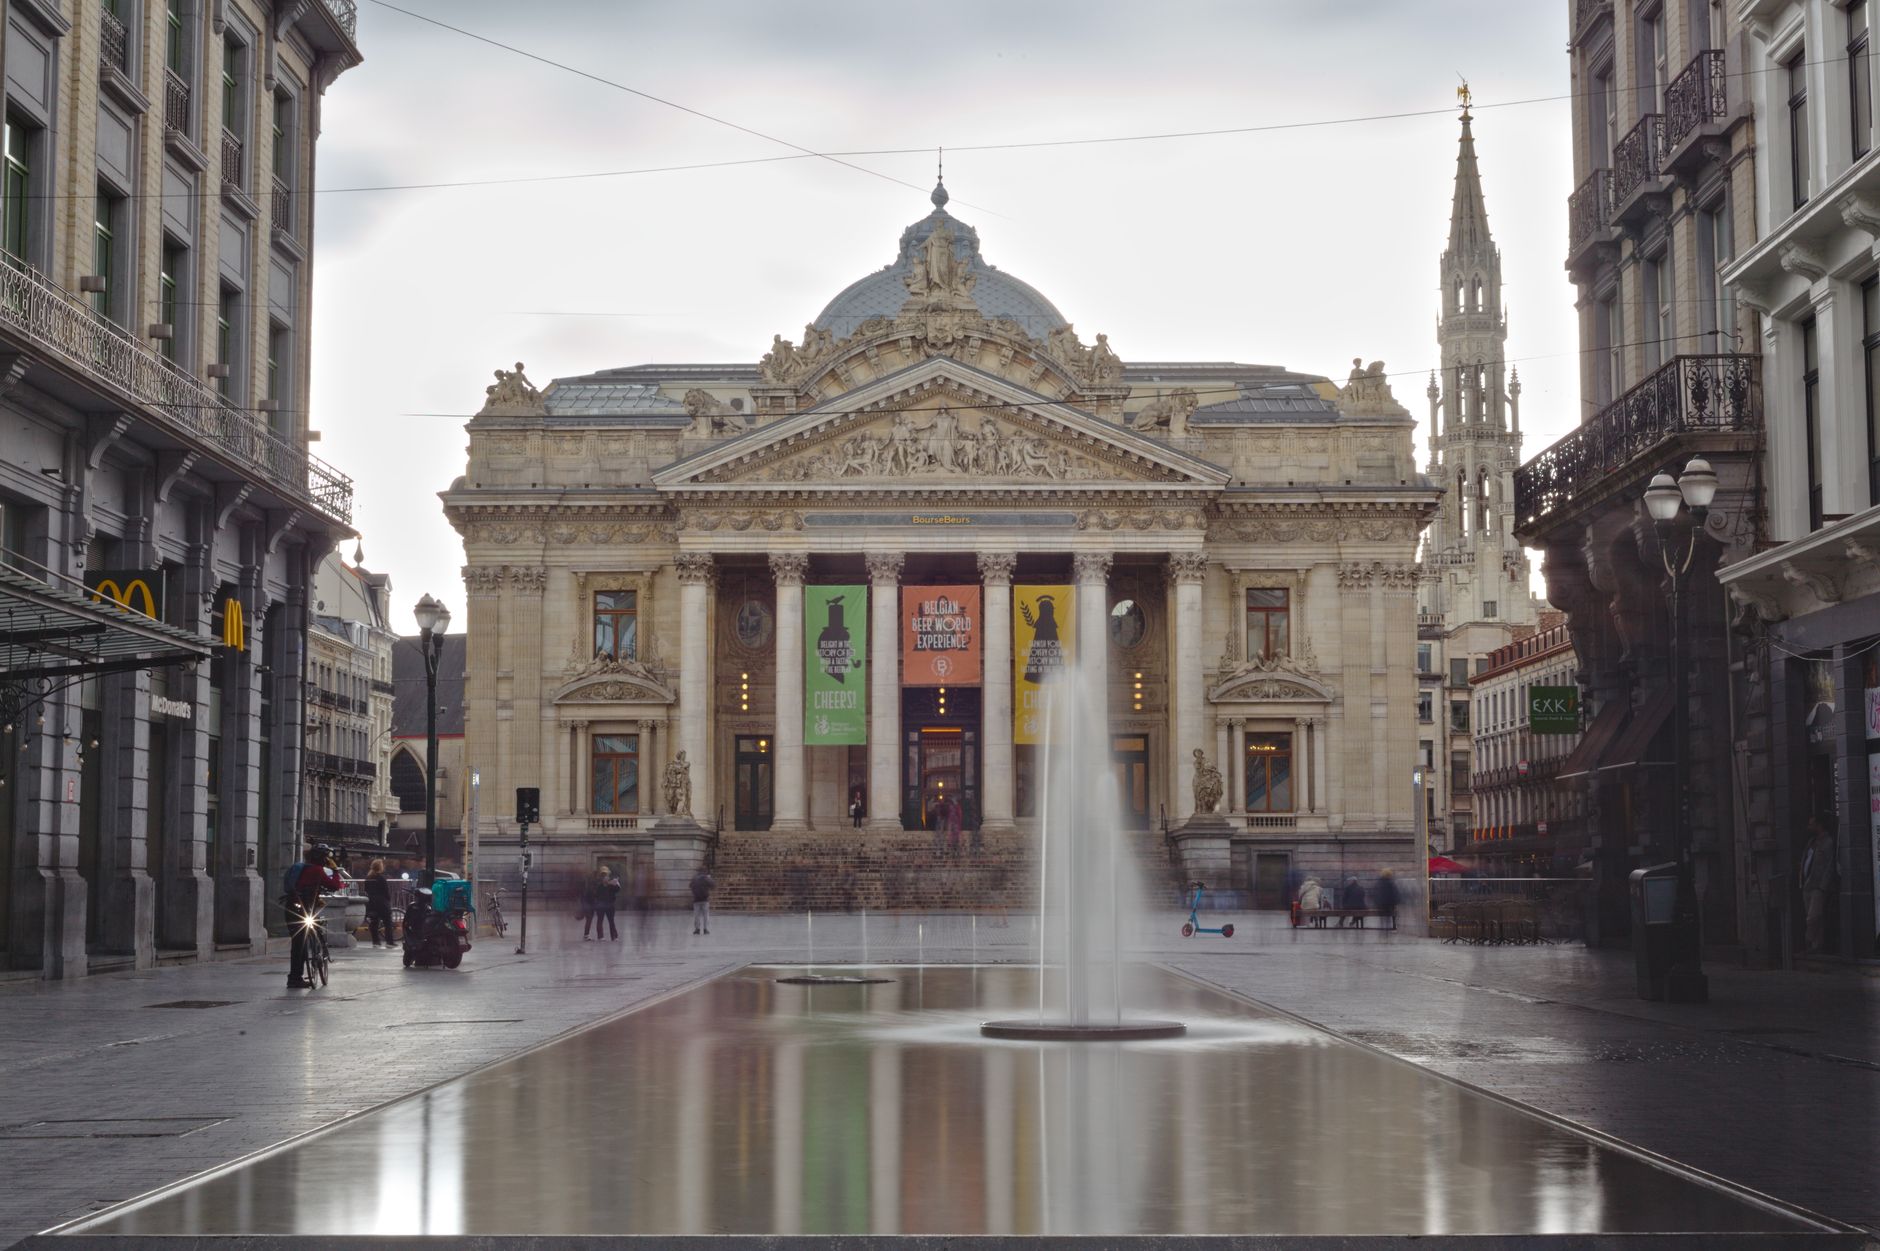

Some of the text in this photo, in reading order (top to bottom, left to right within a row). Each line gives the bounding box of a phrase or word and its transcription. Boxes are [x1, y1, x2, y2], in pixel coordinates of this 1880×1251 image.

[912, 616, 972, 632] BEER WORLD
[152, 694, 191, 719] McDonald's
[814, 690, 857, 709] CHEERS!
